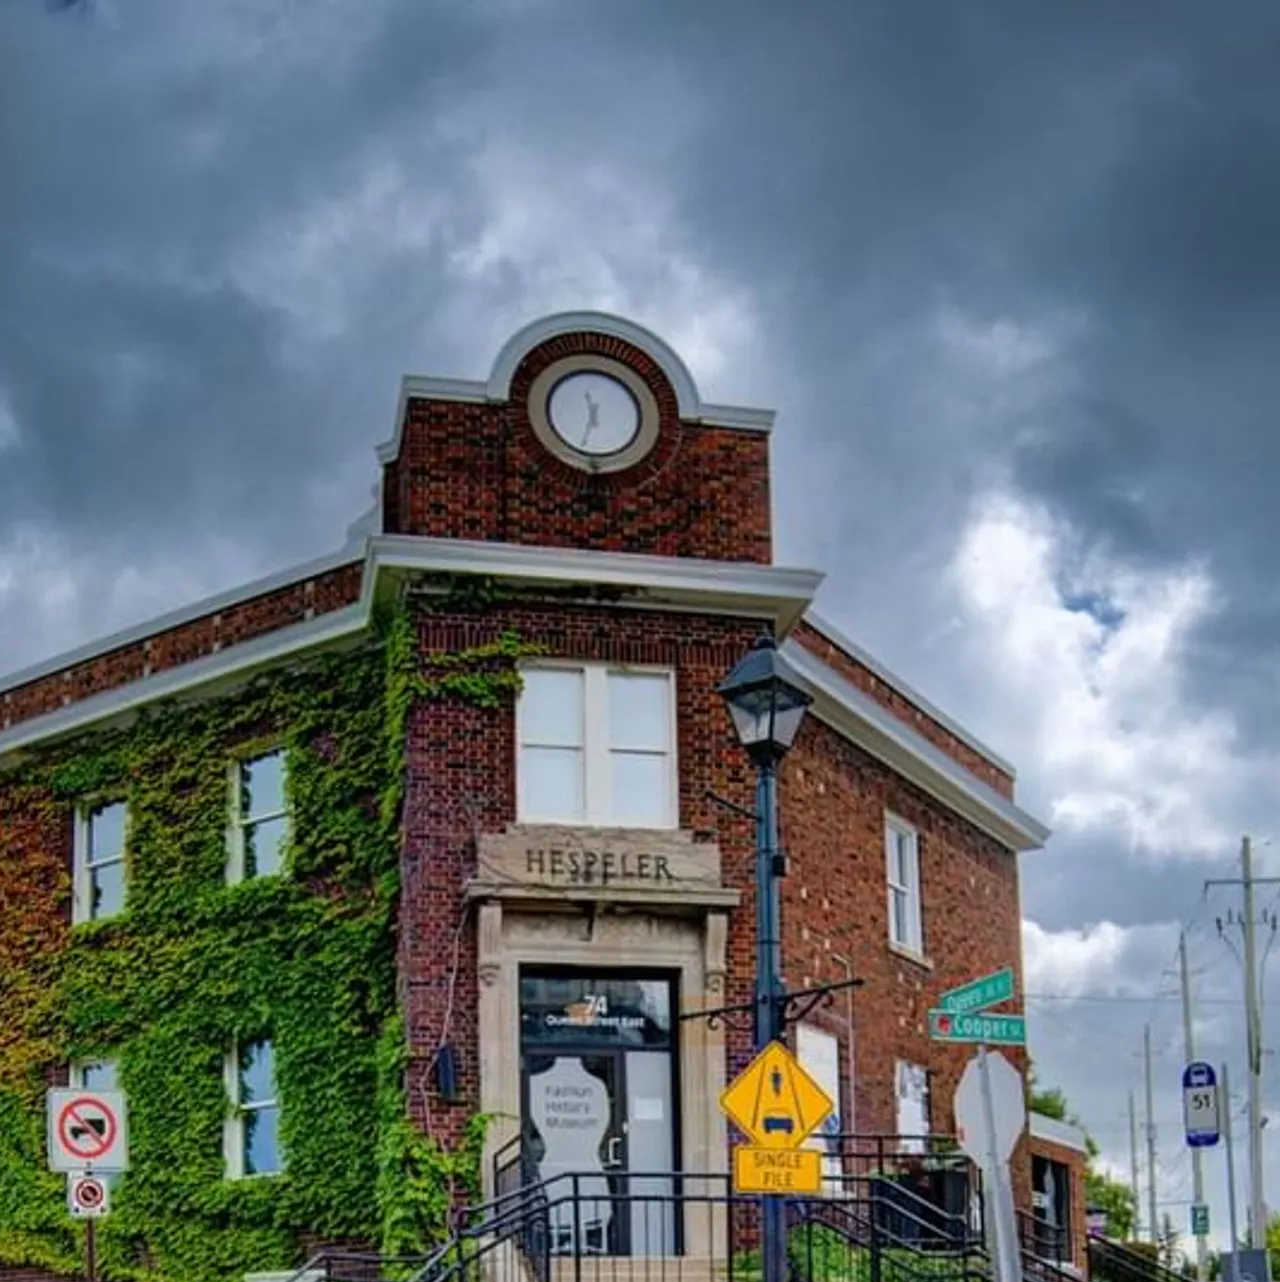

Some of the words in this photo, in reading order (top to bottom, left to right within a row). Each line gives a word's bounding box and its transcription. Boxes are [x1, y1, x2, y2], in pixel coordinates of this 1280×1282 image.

[526, 848, 673, 881] HESPELER
[583, 995, 608, 1014] 74
[954, 1013, 1007, 1037] Cooper
[1192, 1093, 1210, 1110] 51
[753, 1151, 805, 1169] SINGLE
[763, 1171, 794, 1188] FILE
